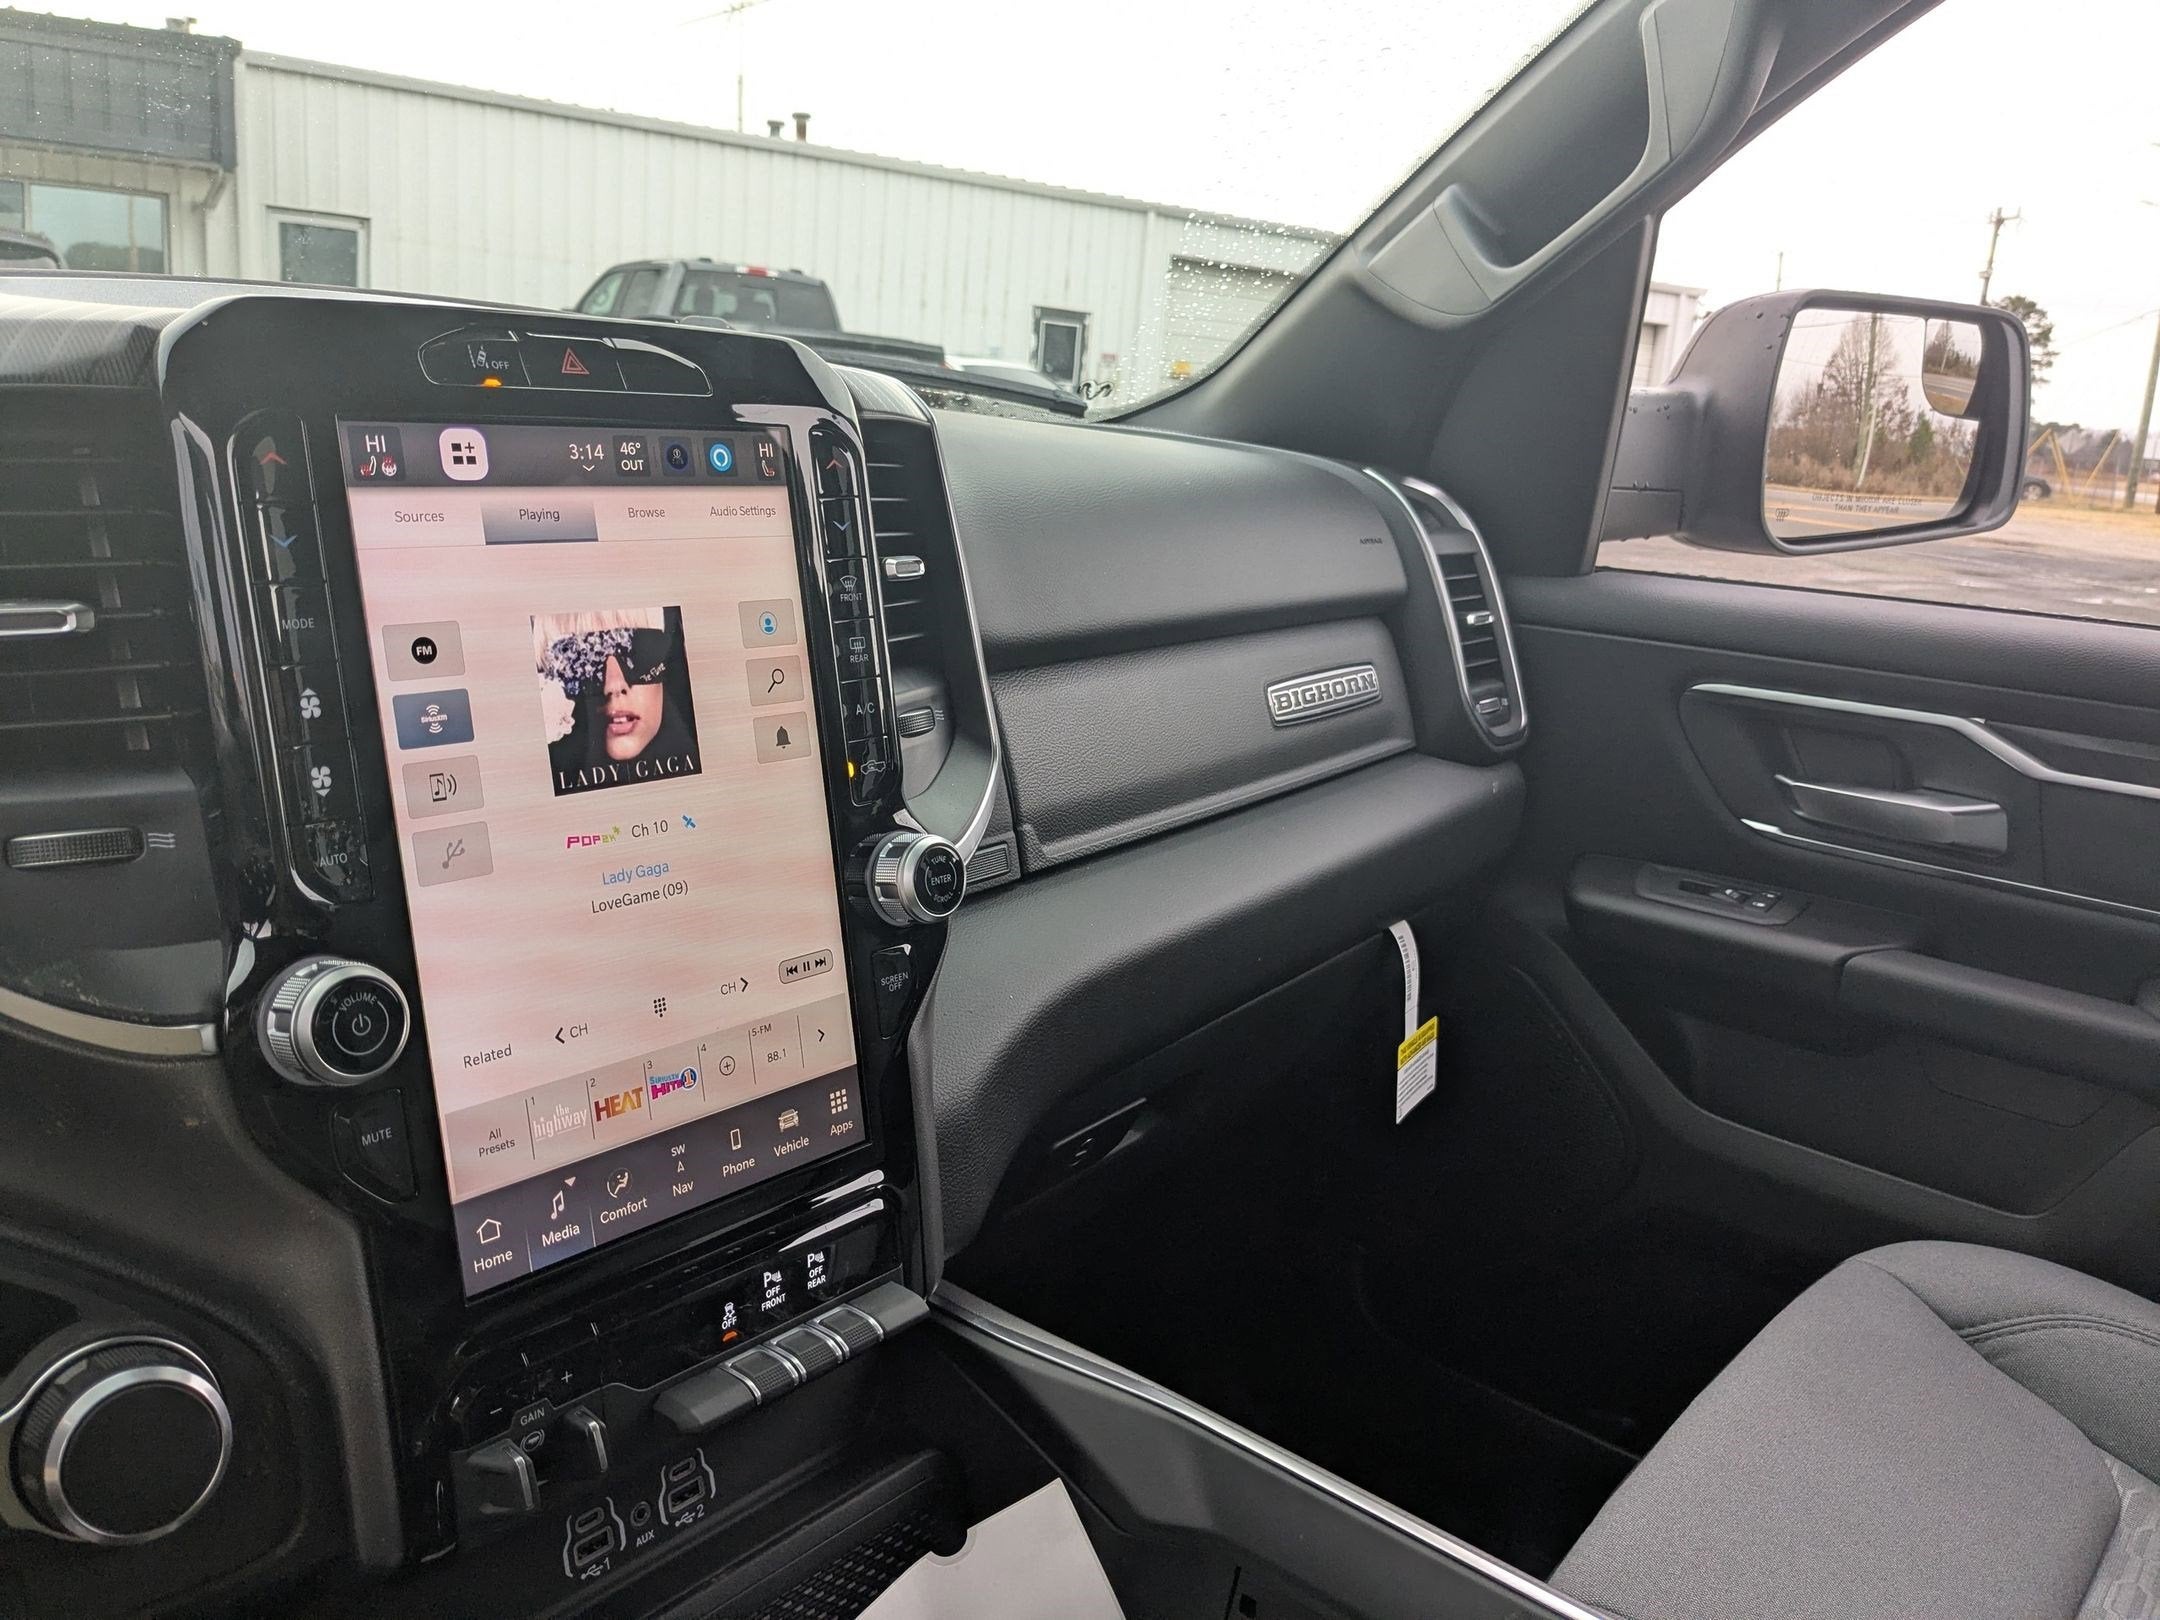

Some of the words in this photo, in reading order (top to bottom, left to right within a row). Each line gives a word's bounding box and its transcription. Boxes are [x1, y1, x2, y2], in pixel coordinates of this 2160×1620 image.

[491, 360, 510, 370] OFF
[365, 434, 387, 453] HI
[620, 441, 641, 456] 46°
[758, 443, 774, 458] HI
[568, 443, 605, 461] 3:14
[621, 459, 644, 472] OUT
[394, 510, 445, 523] Sources
[519, 508, 561, 523] Playing
[627, 506, 666, 518] Browse
[709, 506, 738, 517] Audio
[739, 505, 777, 518] Settings
[839, 593, 864, 603] FRONT
[281, 618, 316, 631] MODE
[415, 645, 433, 656] FM
[850, 653, 869, 663] REAR
[1271, 672, 1377, 714] BIGHORN
[855, 702, 876, 716] A/C
[559, 763, 620, 790] LADY
[635, 754, 694, 778] GAGA
[631, 823, 650, 838] Ch
[653, 819, 669, 835] 10
[319, 852, 349, 868] AUTO
[931, 855, 947, 865] TUNE
[602, 866, 633, 886] Lady
[635, 861, 670, 880] Gaga
[930, 873, 952, 886] ENTER
[591, 888, 661, 914] LoveGame
[662, 880, 689, 900] (09)
[880, 971, 909, 986] SCREEN
[720, 981, 737, 996] CH
[888, 981, 902, 992] OFF
[338, 991, 378, 1012] VOLUME
[569, 1022, 589, 1039] CH
[700, 1043, 707, 1052] 4
[463, 1043, 513, 1069] Related
[767, 1048, 788, 1063] 88.1
[647, 1060, 653, 1070] 3
[589, 1077, 596, 1088] 2
[594, 1086, 644, 1122] HEAT
[532, 1108, 588, 1138] highway
[829, 1119, 854, 1136] Apps
[361, 1126, 393, 1147] MUTE
[488, 1127, 502, 1141] All
[478, 1138, 516, 1158] Presets
[671, 1143, 686, 1157] SW
[773, 1135, 810, 1158] Vehicle
[722, 1157, 756, 1178] Phone
[672, 1180, 694, 1197] Nav
[600, 1197, 648, 1225] Comfort
[541, 1223, 581, 1247] Media
[473, 1249, 513, 1274] Home
[809, 1265, 824, 1279] OFF
[807, 1274, 827, 1290] REAR
[765, 1284, 781, 1299] OFF
[761, 1292, 787, 1312] FRONT
[721, 1315, 737, 1330] OFF
[519, 1406, 546, 1427] GAIN
[696, 1503, 705, 1519] 2
[635, 1528, 656, 1548] AUX
